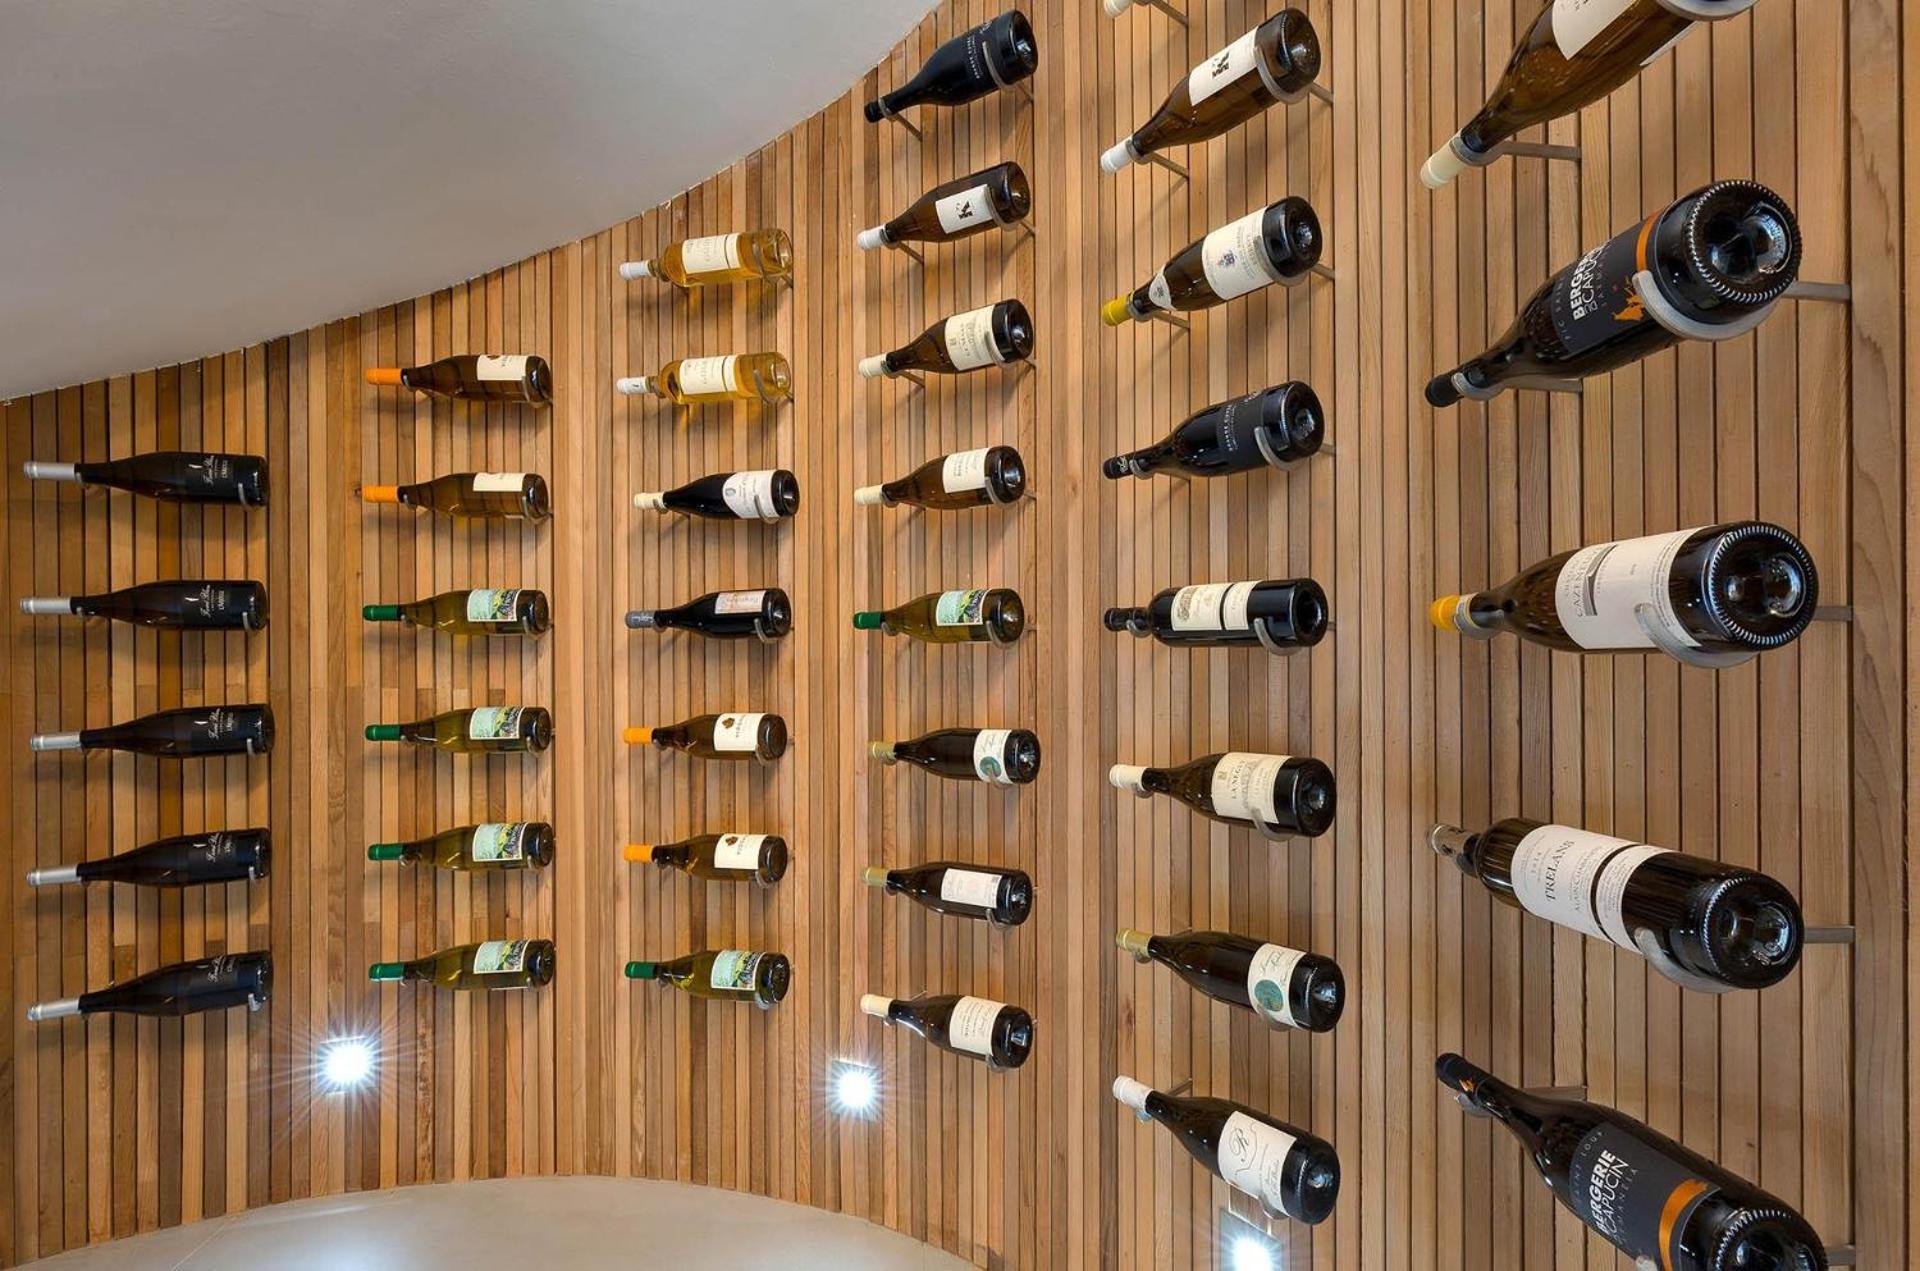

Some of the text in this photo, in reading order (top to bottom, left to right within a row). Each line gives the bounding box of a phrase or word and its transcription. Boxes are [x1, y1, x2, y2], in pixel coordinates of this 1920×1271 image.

[1545, 840, 1575, 902] TRELANS
[1589, 1150, 1616, 1236] BERGERIE
[1601, 1158, 1629, 1233] CAPUCIN
